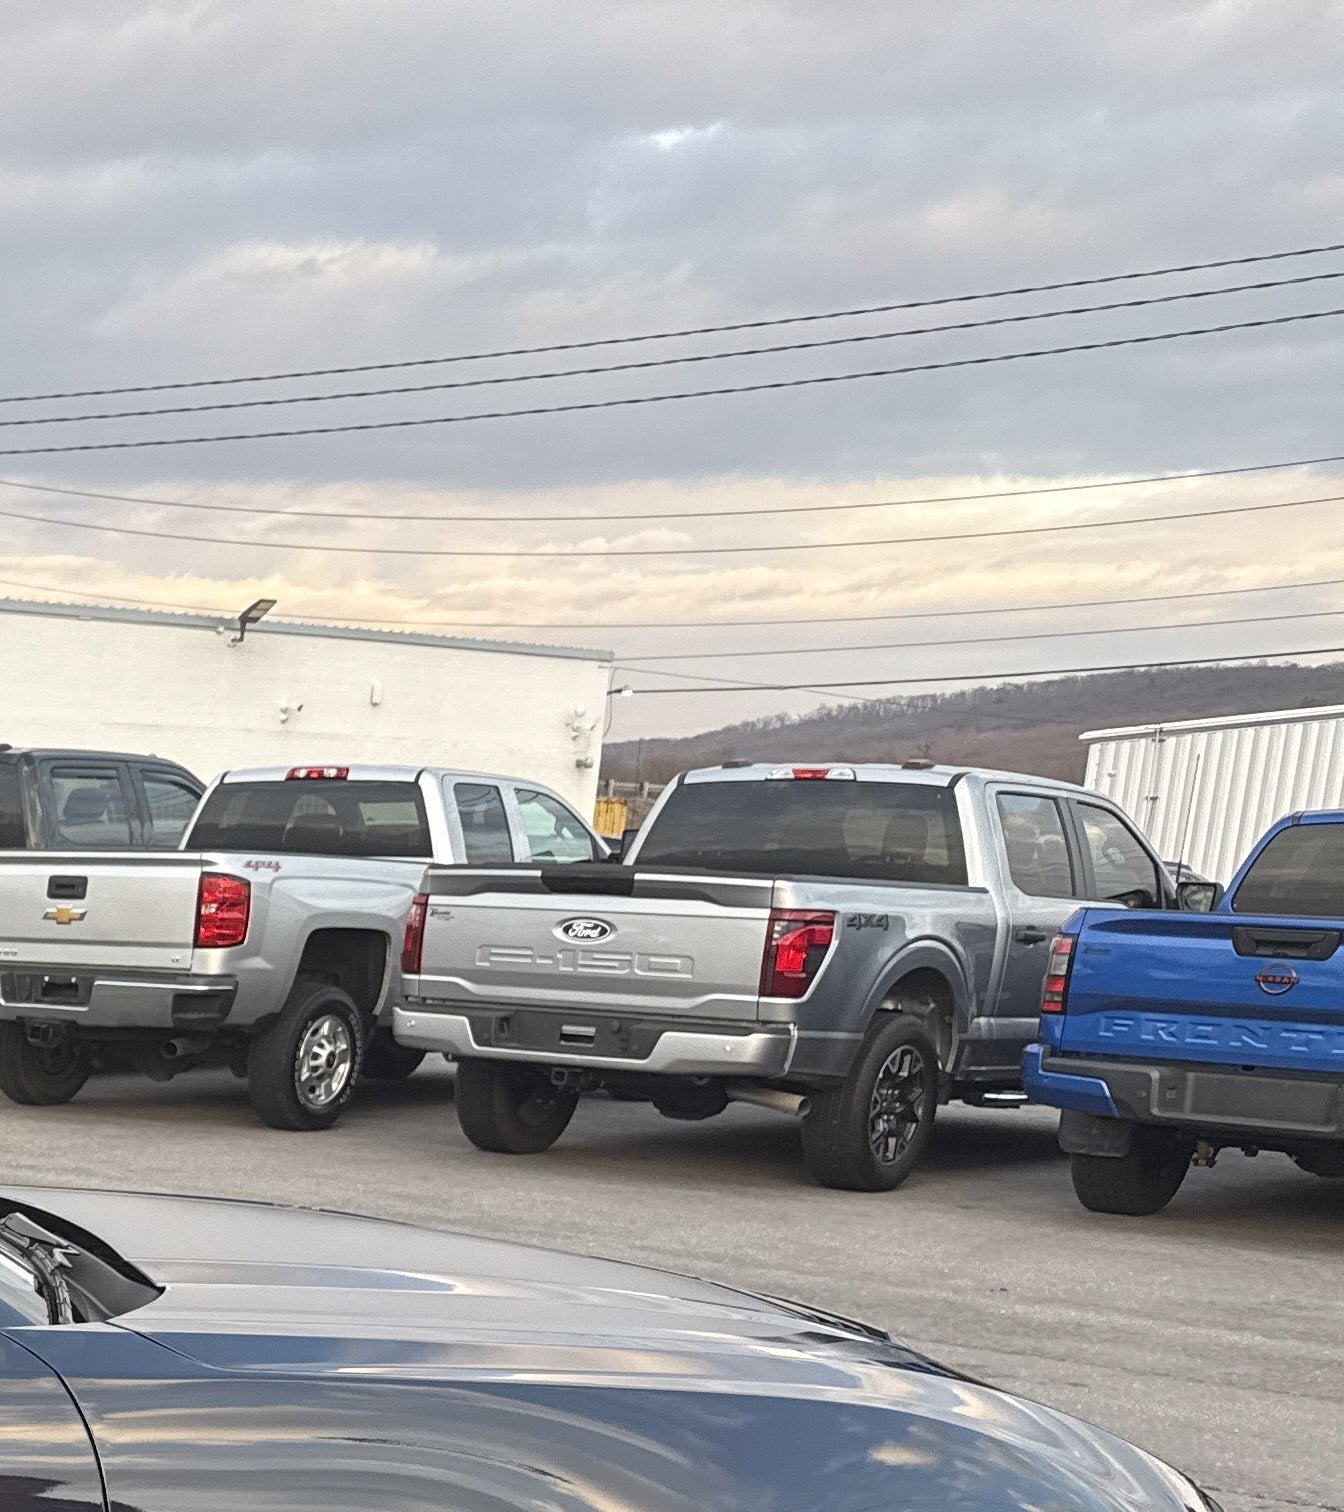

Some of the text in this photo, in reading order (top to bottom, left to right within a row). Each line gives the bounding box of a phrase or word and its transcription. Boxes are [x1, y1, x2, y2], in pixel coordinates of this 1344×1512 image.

[567, 921, 602, 938] Ford
[475, 944, 696, 979] F-150
[1255, 974, 1300, 985] NISSAN
